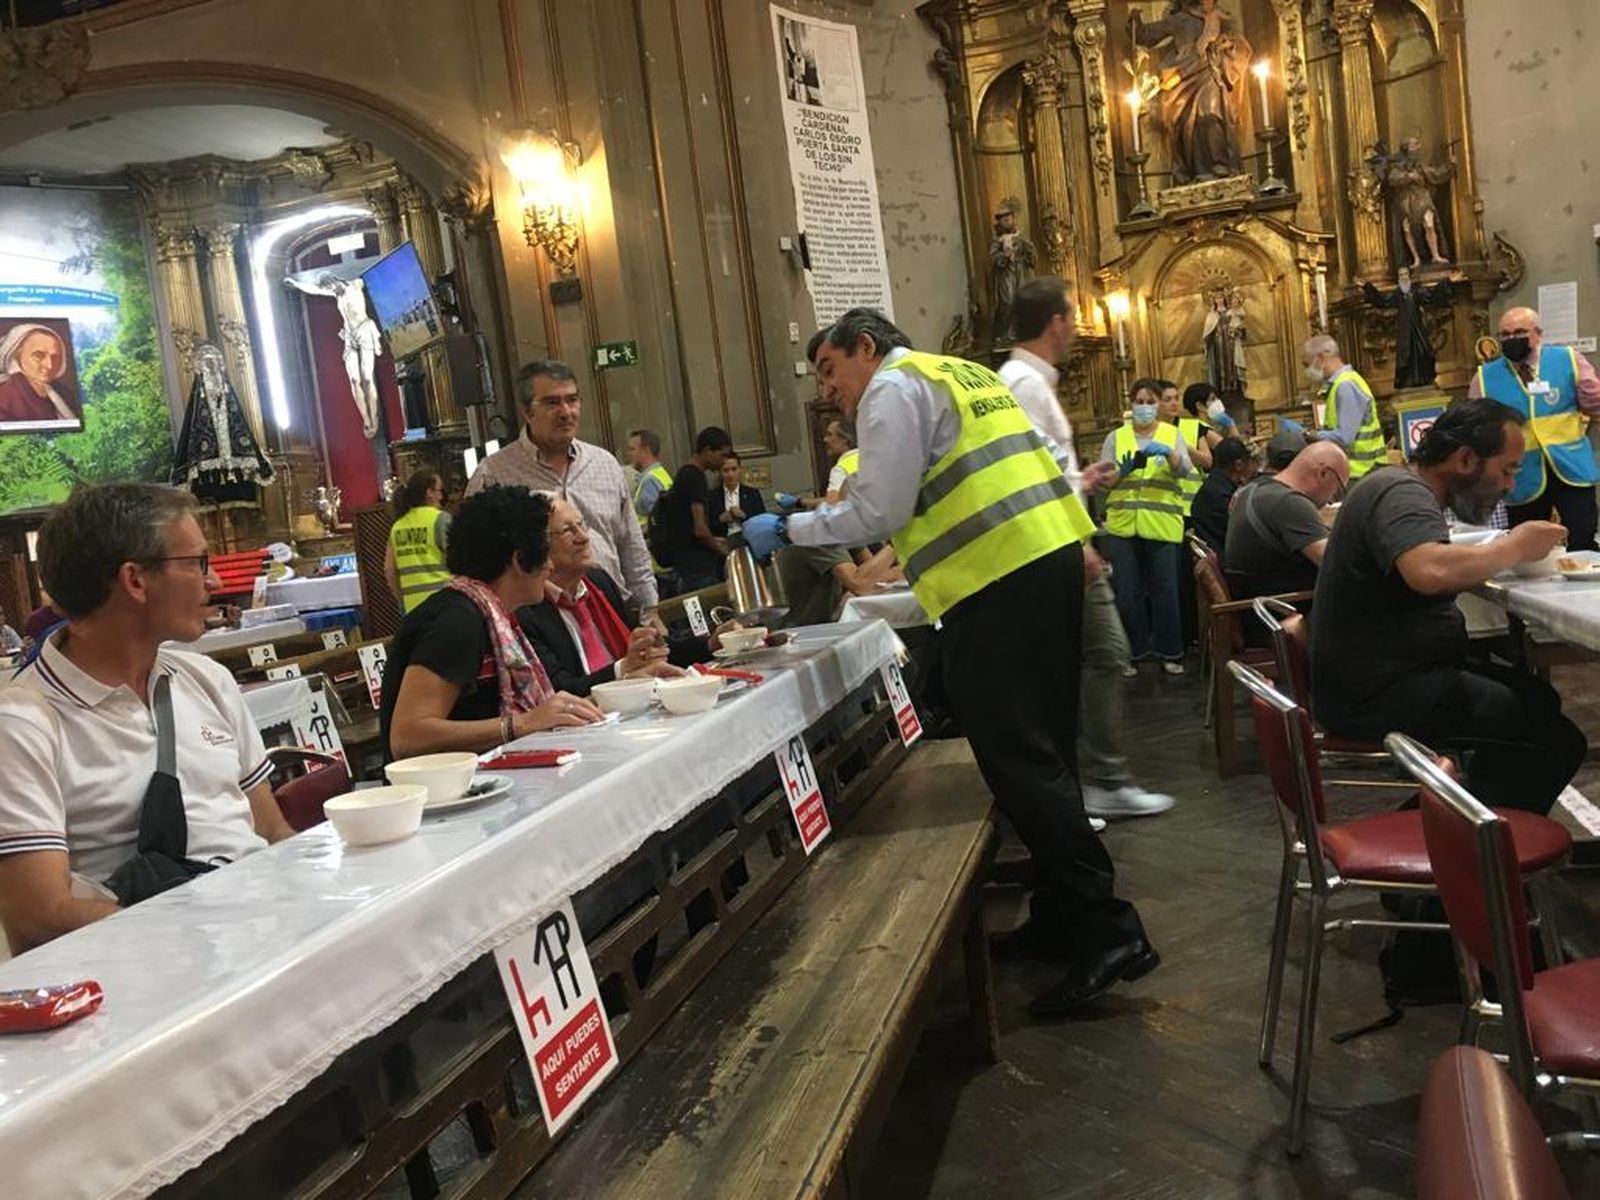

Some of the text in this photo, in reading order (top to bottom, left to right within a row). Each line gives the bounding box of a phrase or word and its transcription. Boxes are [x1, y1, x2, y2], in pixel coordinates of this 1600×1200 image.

[793, 126, 862, 146] CARLOS OSORO
[801, 118, 848, 135] CARDENAL
[796, 137, 860, 155] PUERTA SANTA
[805, 148, 853, 164] DE LOS SIN
[564, 1012, 601, 1056] PUEDES
[555, 1042, 601, 1099] SENTARTE
